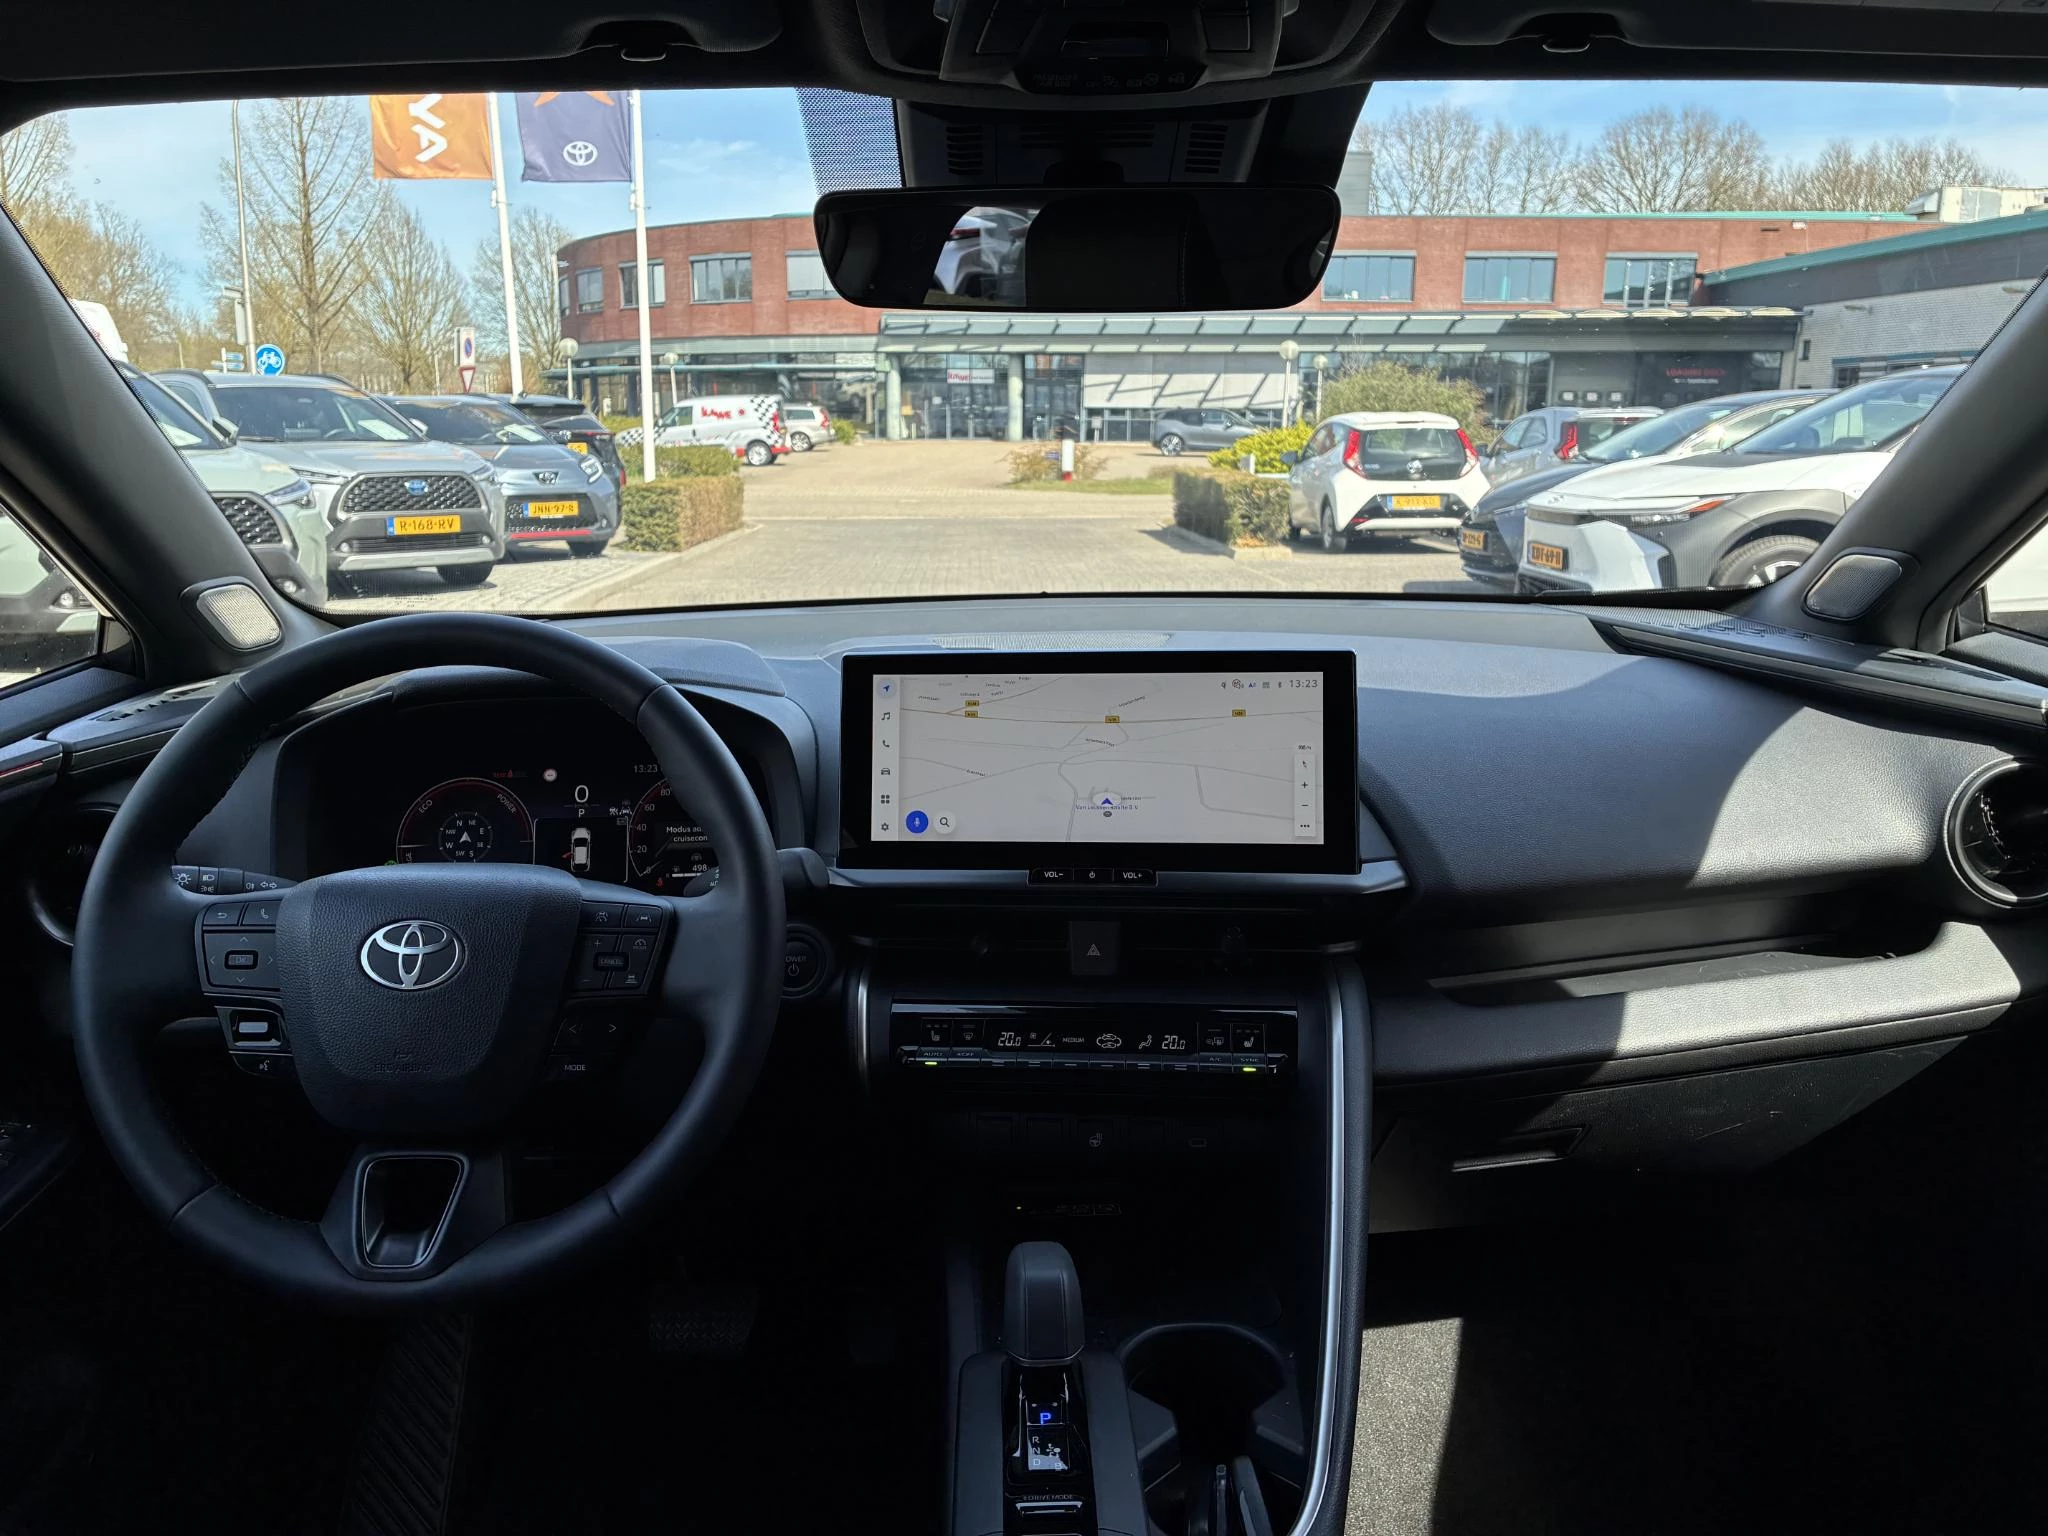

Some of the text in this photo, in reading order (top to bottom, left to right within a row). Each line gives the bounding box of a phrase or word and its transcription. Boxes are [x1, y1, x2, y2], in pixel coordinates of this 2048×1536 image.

[400, 518, 454, 531] R-168-RV
[1289, 679, 1318, 688] 13:23
[634, 765, 658, 773] 13:23
[418, 799, 433, 814] ECO
[497, 793, 518, 813] POWER
[578, 808, 585, 818] P
[636, 824, 647, 832] 40
[636, 845, 647, 853] 20
[692, 864, 708, 872] 498
[998, 1032, 1021, 1046] 20.0
[1161, 1035, 1185, 1050] 20.0
[1040, 1412, 1052, 1425] P
